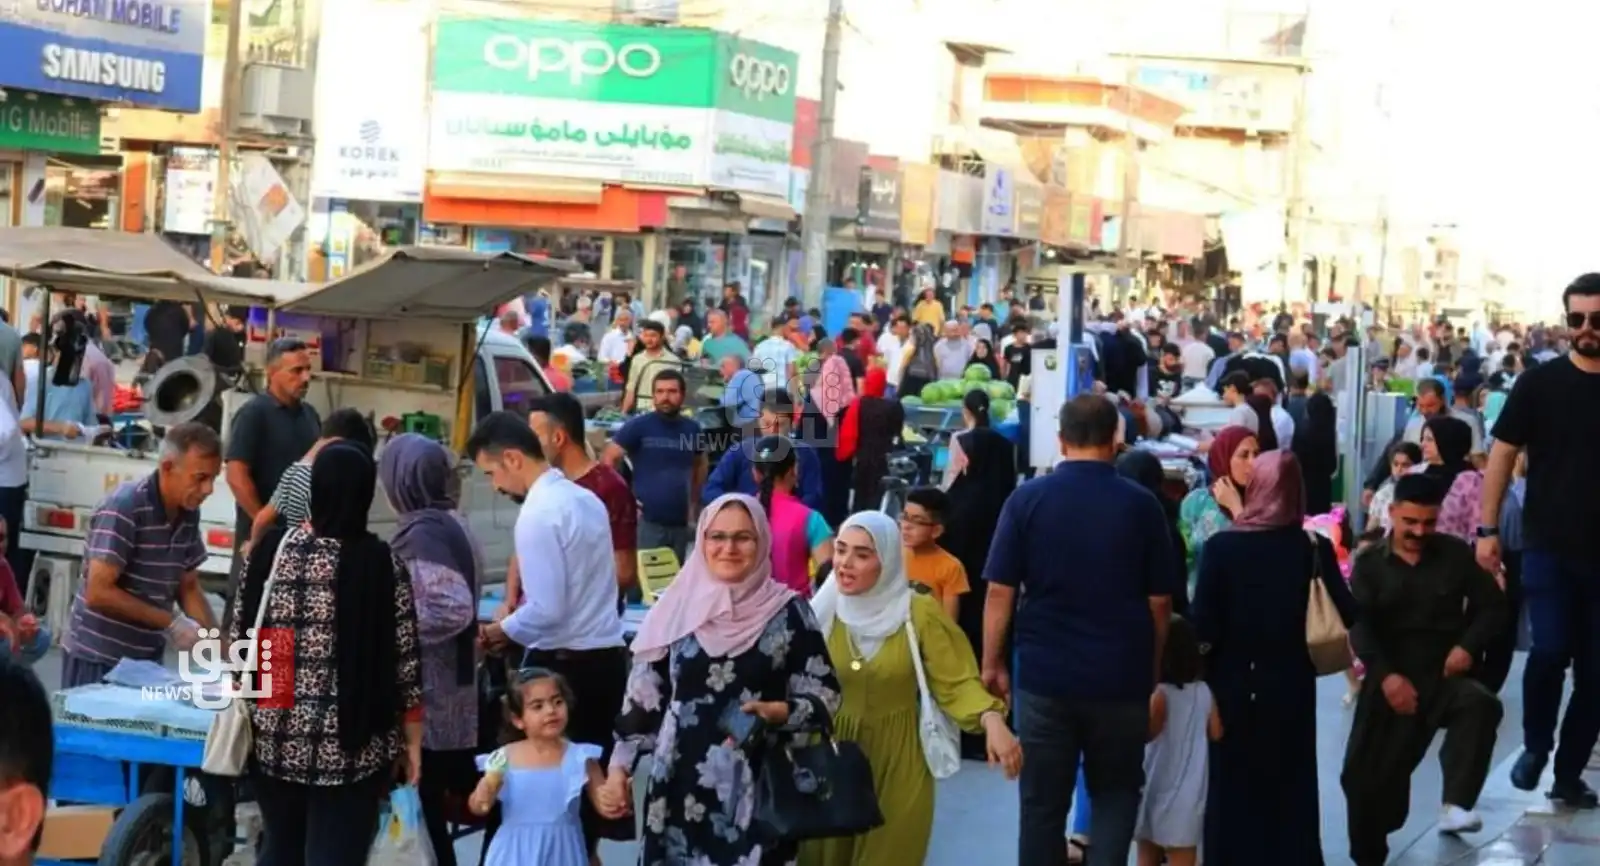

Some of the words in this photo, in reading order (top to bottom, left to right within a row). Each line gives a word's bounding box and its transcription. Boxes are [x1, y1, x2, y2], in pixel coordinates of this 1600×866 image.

[110, 0, 181, 34] MOBILE
[42, 43, 165, 93] SAMSUNG
[484, 34, 661, 85] oppo
[730, 53, 789, 101] oppo
[29, 107, 92, 140] Mobile
